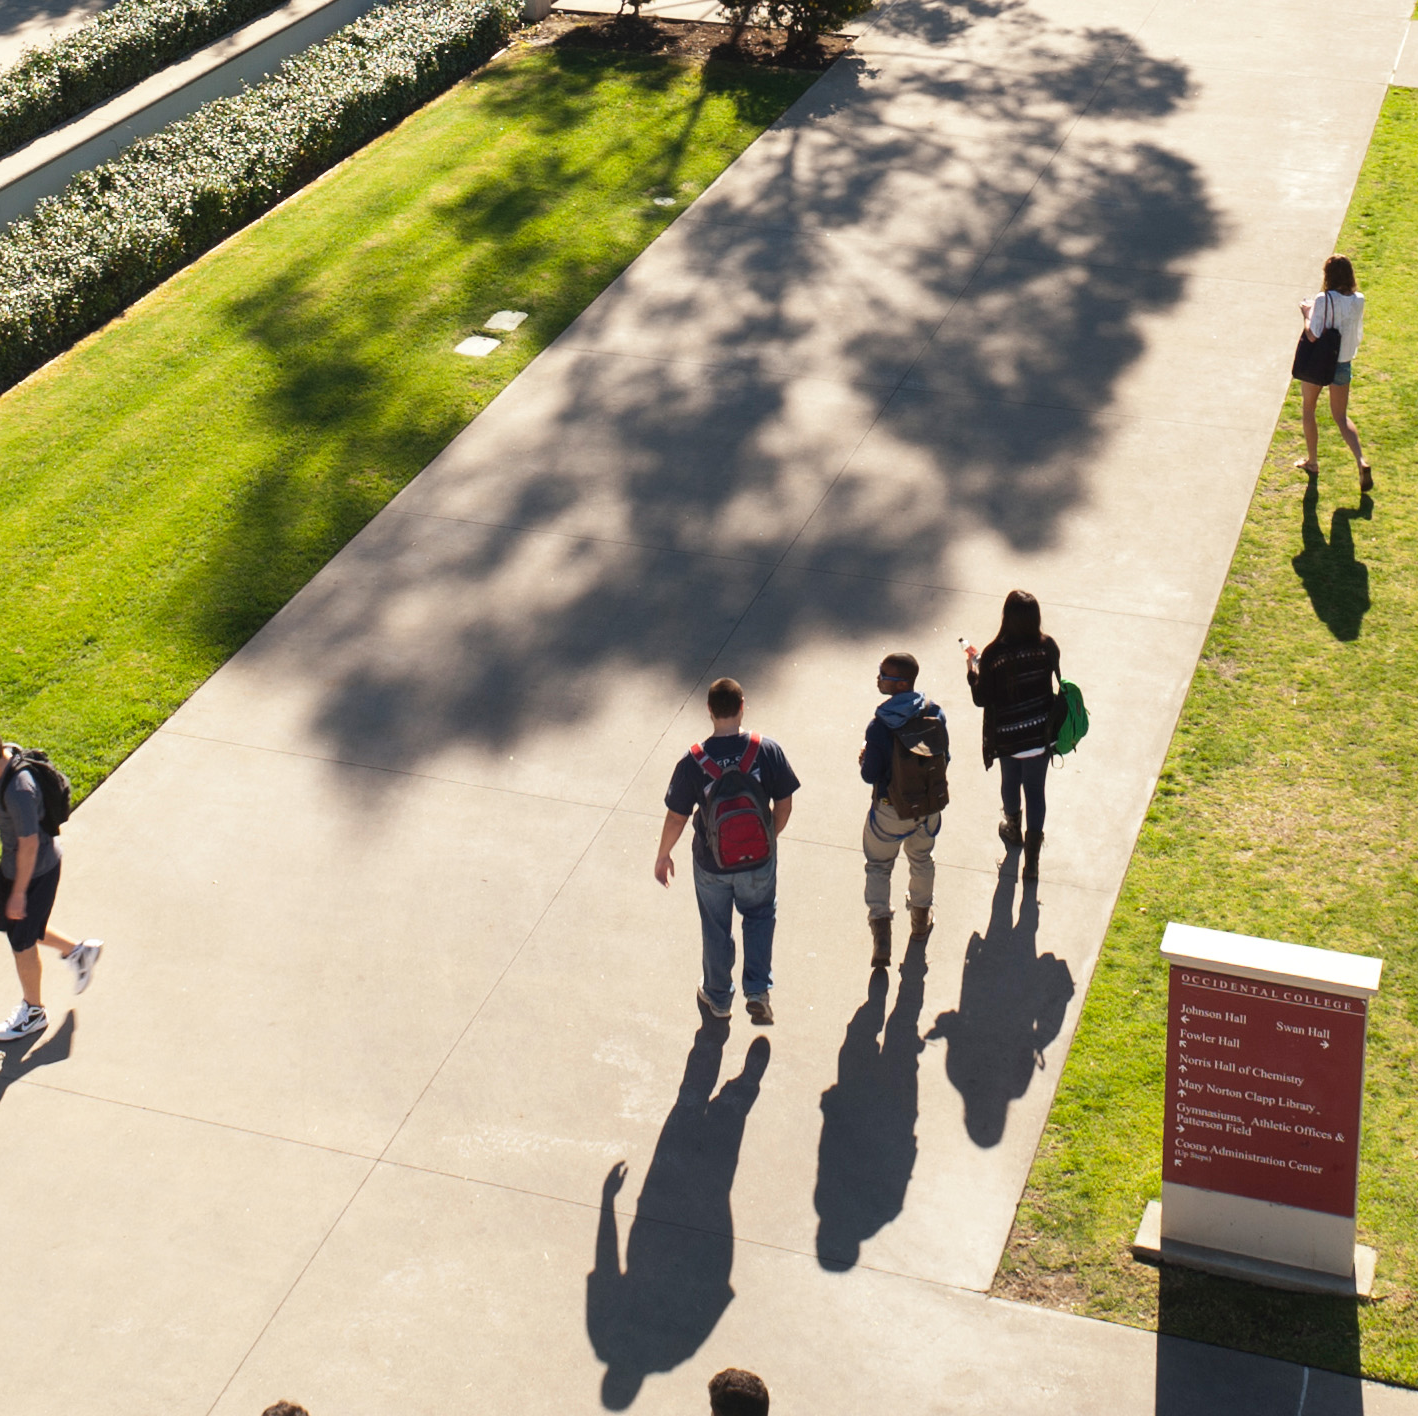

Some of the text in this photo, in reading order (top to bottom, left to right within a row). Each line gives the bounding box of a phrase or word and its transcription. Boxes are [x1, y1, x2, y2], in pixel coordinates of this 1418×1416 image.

[1181, 973, 1352, 1011] OCCIDENTAL COLLEGE
[1180, 1003, 1247, 1024] Johnson Hall
[1180, 1028, 1240, 1048] Fowler Hall
[1276, 1021, 1330, 1039] Swan Hall
[1179, 1053, 1305, 1087] Norris Hall of Chemistry
[1178, 1078, 1203, 1093] Mary
[1206, 1083, 1242, 1098] Norton
[1244, 1091, 1276, 1107] Clapp
[1176, 1113, 1252, 1136] Patterson Field
[1251, 1117, 1292, 1133] Athletic
[1294, 1124, 1332, 1140] Offices
[1335, 1132, 1346, 1143] &
[1175, 1137, 1323, 1174] Coons Administration Center
